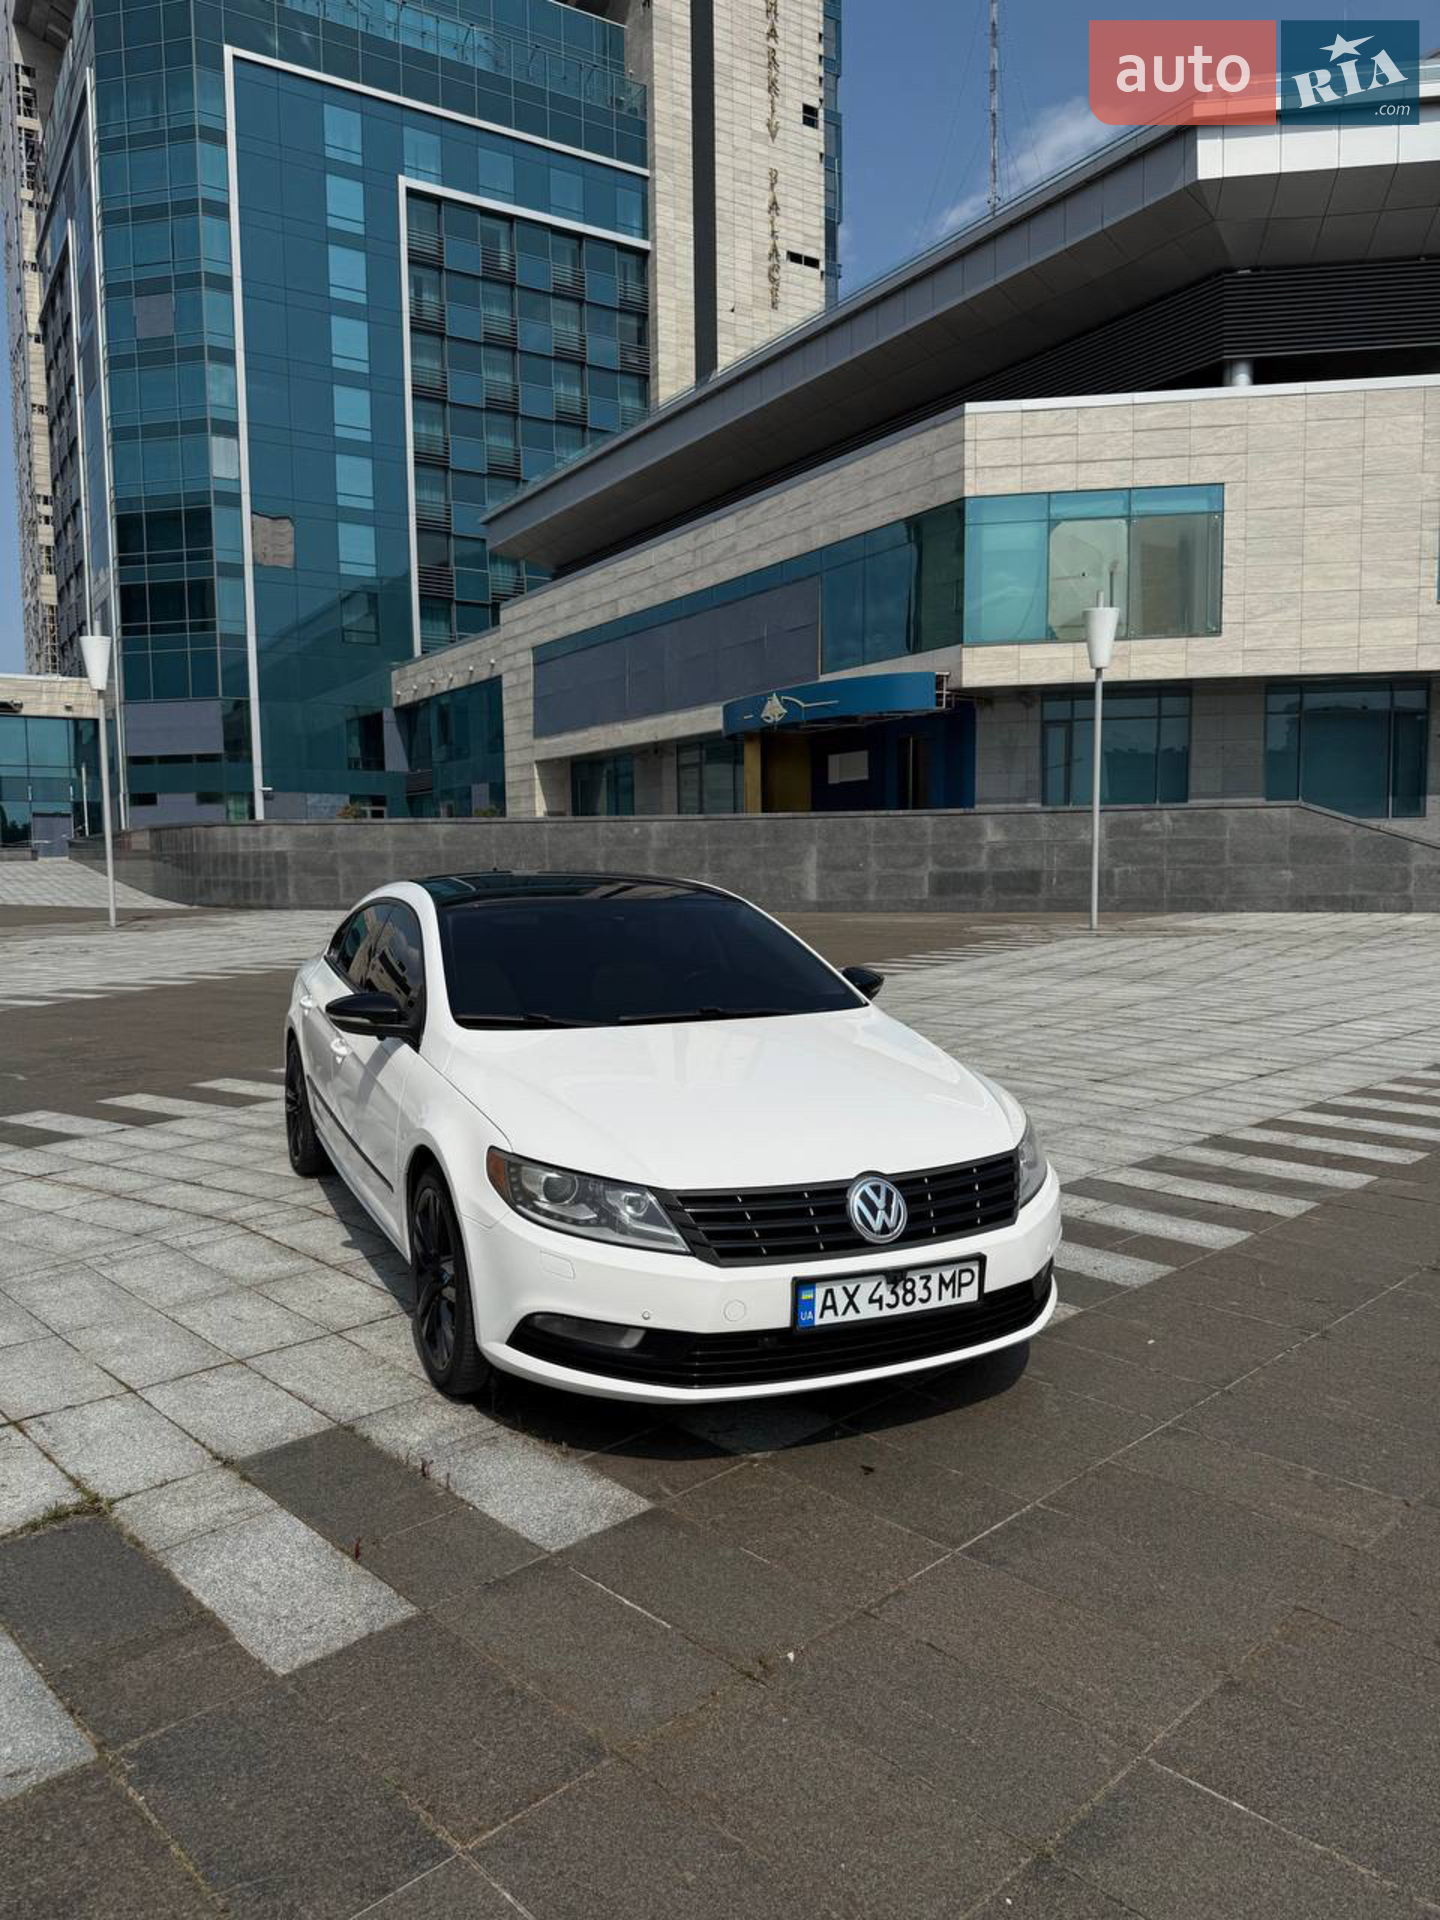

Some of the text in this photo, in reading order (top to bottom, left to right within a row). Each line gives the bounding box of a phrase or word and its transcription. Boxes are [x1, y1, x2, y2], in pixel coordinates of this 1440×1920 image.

[767, 167, 780, 310] PALACE
[801, 1310, 814, 1321] UA
[819, 1268, 975, 1319] AX 4383 MP
